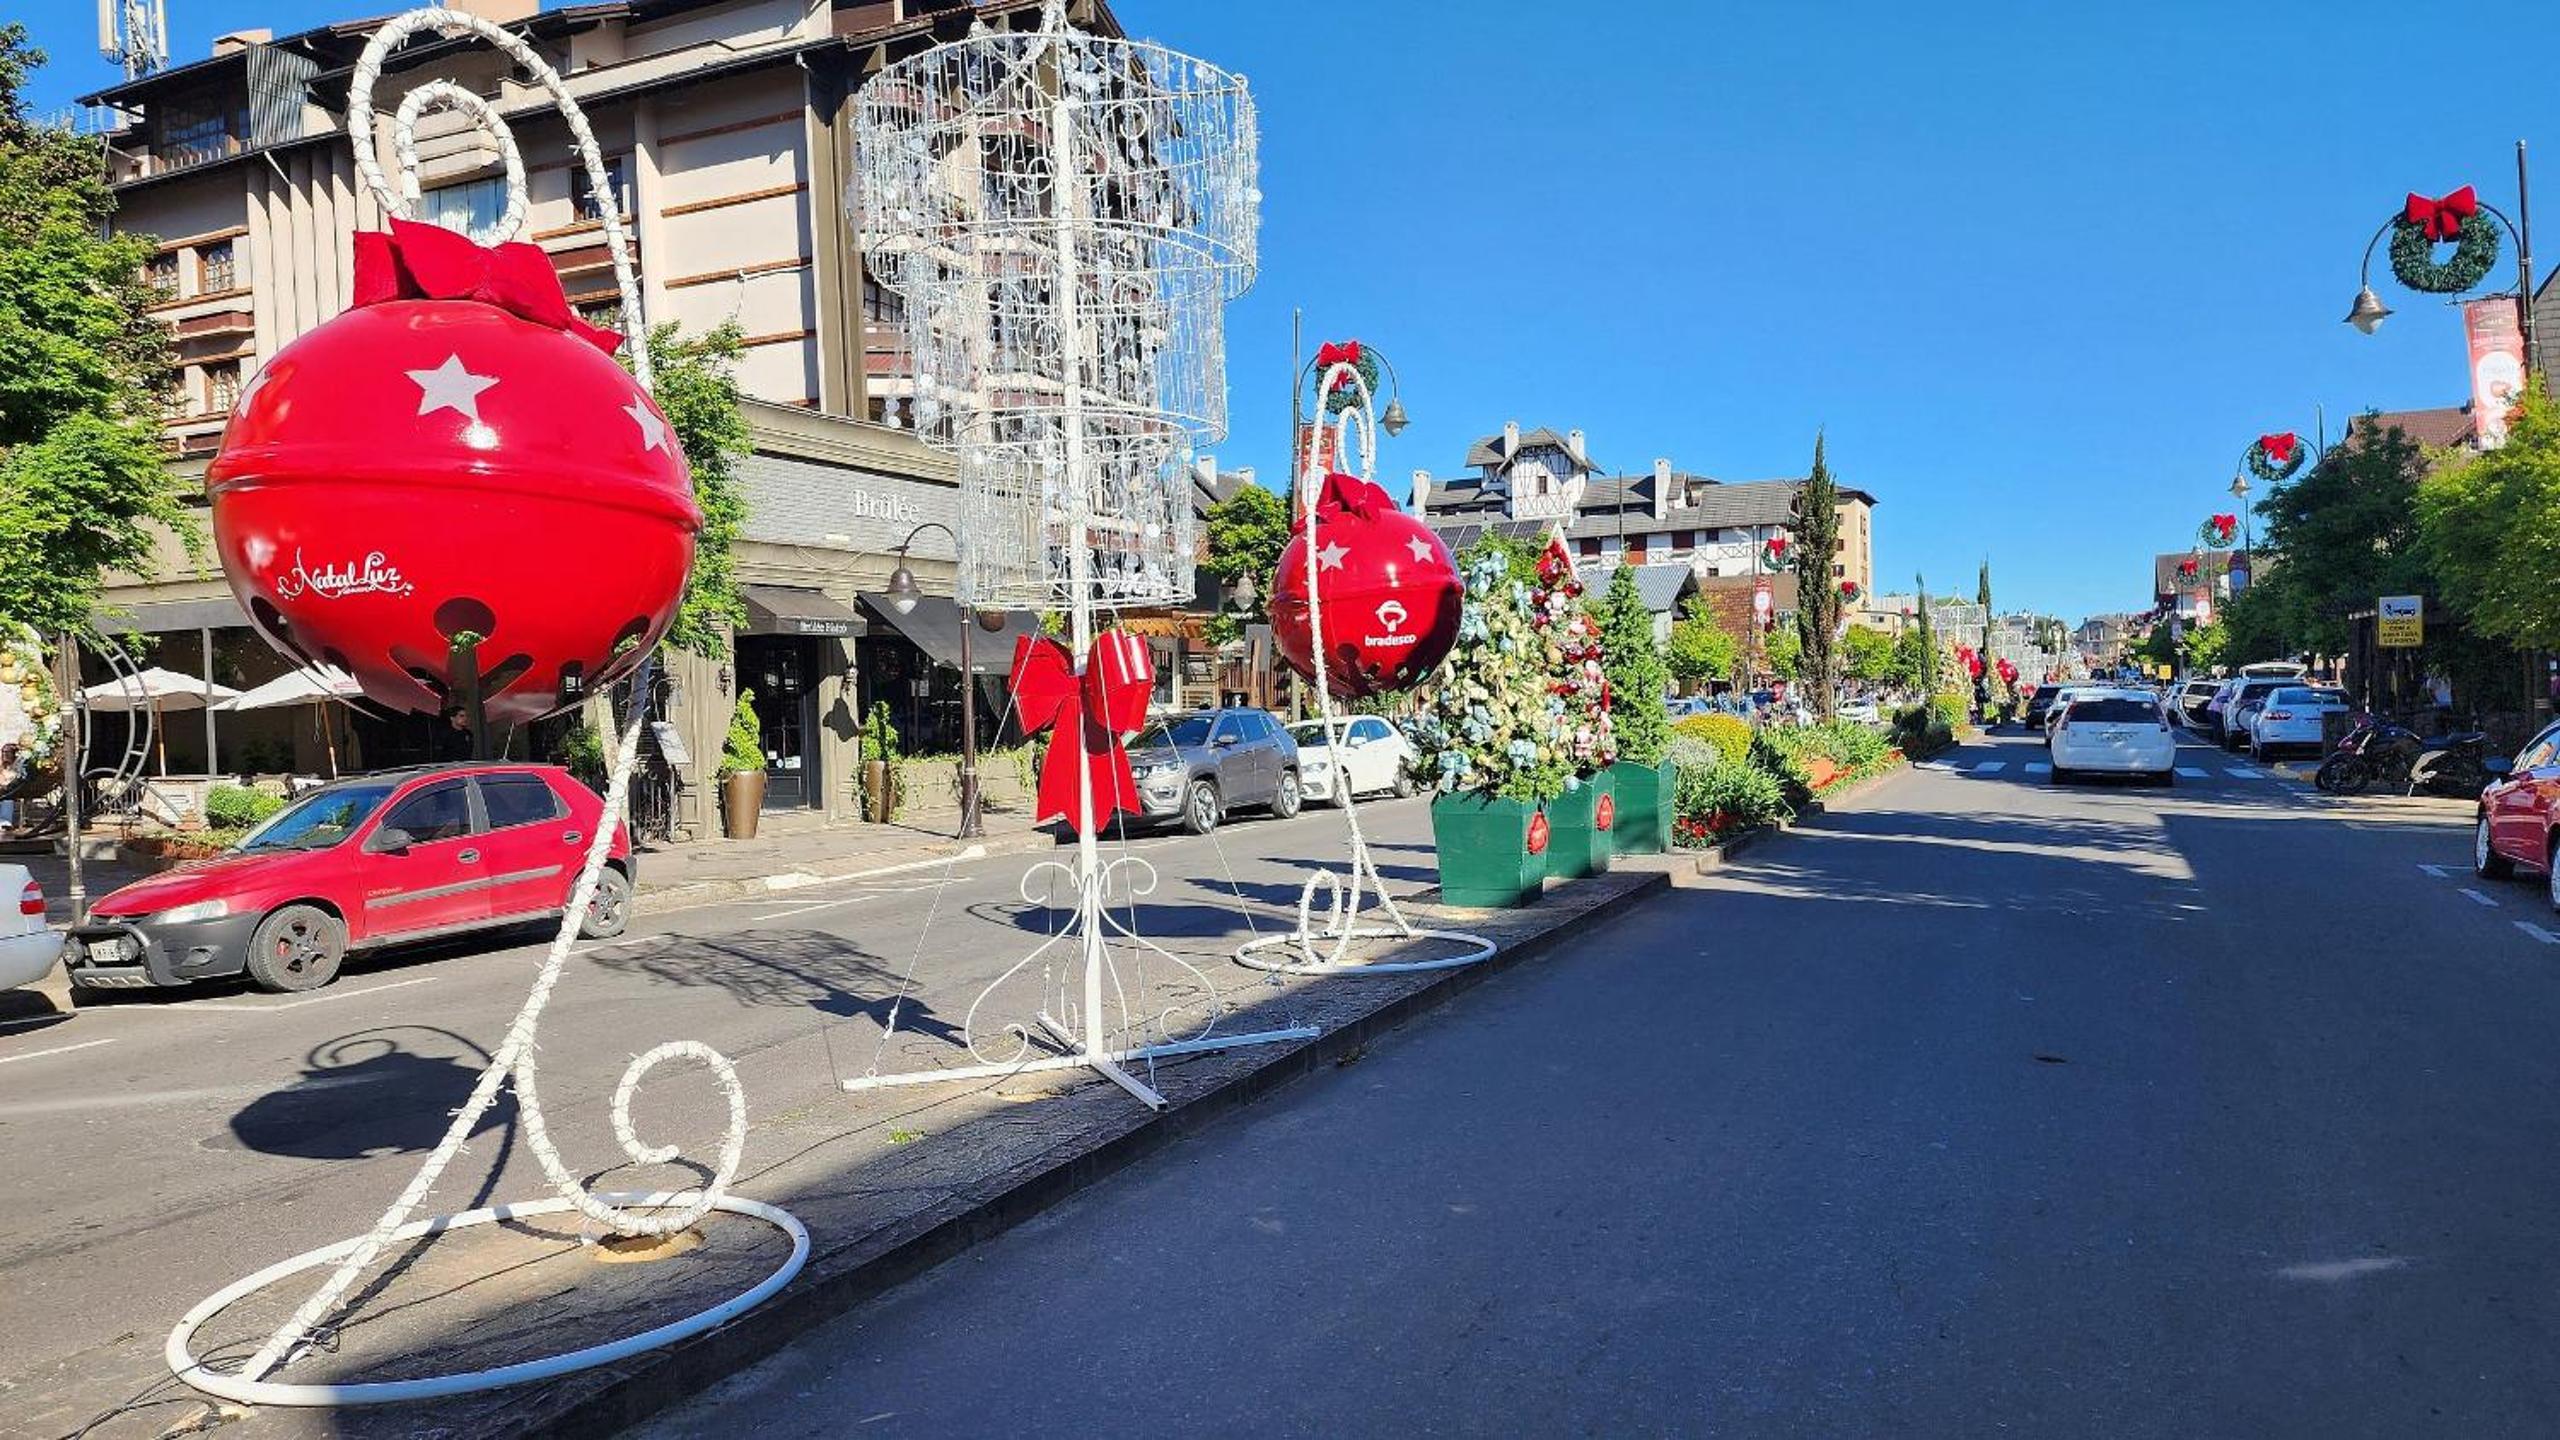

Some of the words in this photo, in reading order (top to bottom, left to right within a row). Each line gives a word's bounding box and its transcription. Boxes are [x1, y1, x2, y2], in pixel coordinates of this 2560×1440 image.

[853, 489, 919, 523] Brûlée
[279, 546, 360, 599] Natal
[358, 551, 405, 592] Luz
[1364, 634, 1417, 647] bradesco
